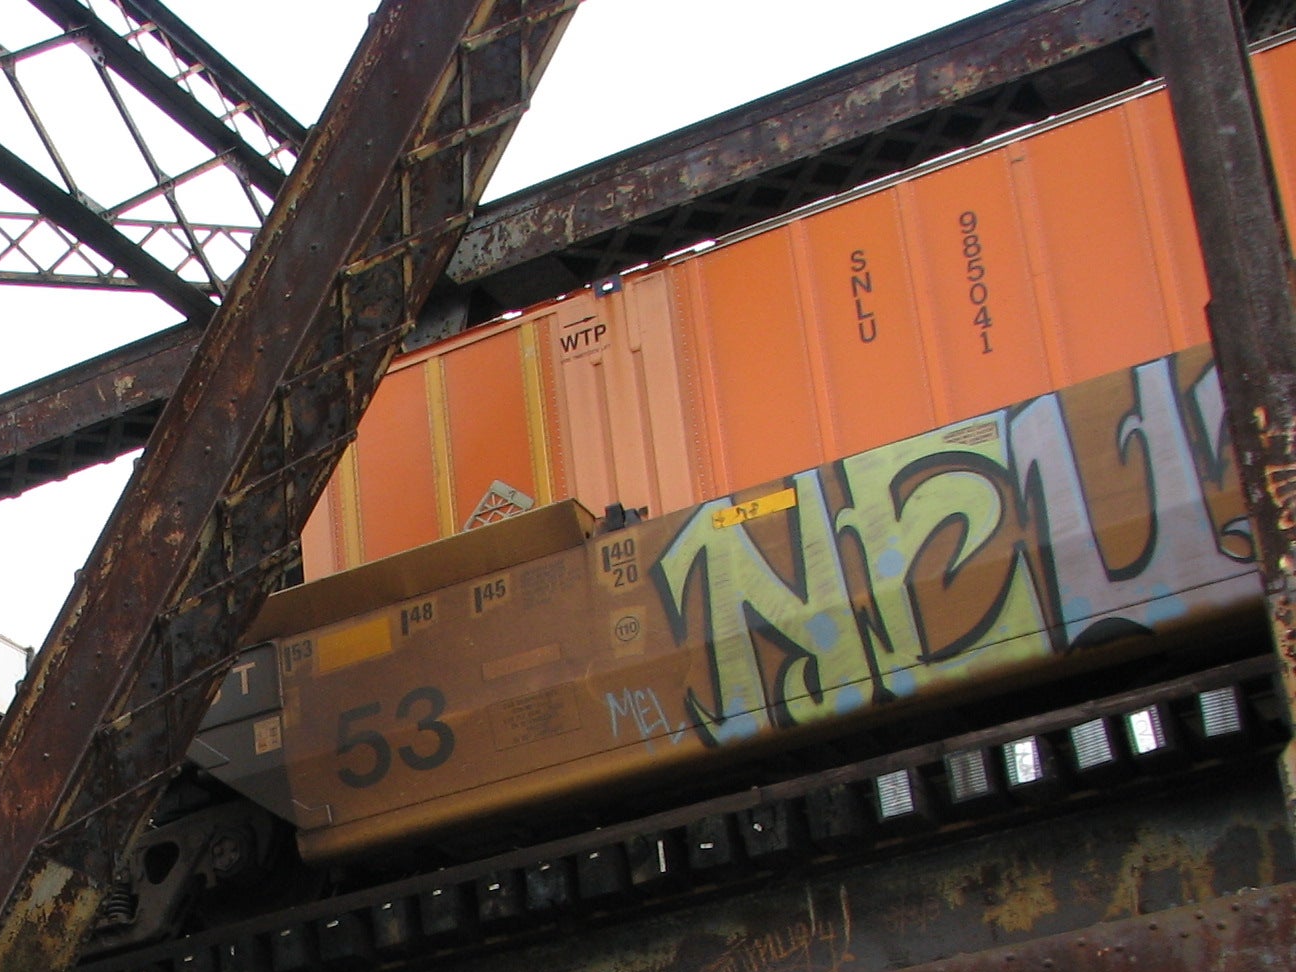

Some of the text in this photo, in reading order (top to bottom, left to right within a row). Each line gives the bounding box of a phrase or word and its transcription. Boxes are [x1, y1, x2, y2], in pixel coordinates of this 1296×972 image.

[959, 211, 993, 355] 985041
[849, 250, 878, 343] SNLU
[560, 324, 606, 353] WTP
[611, 538, 635, 560] 40
[613, 564, 638, 587] 20
[482, 580, 506, 600] 45
[410, 602, 433, 624] 48
[291, 640, 312, 661] 53
[336, 686, 456, 789] 53
